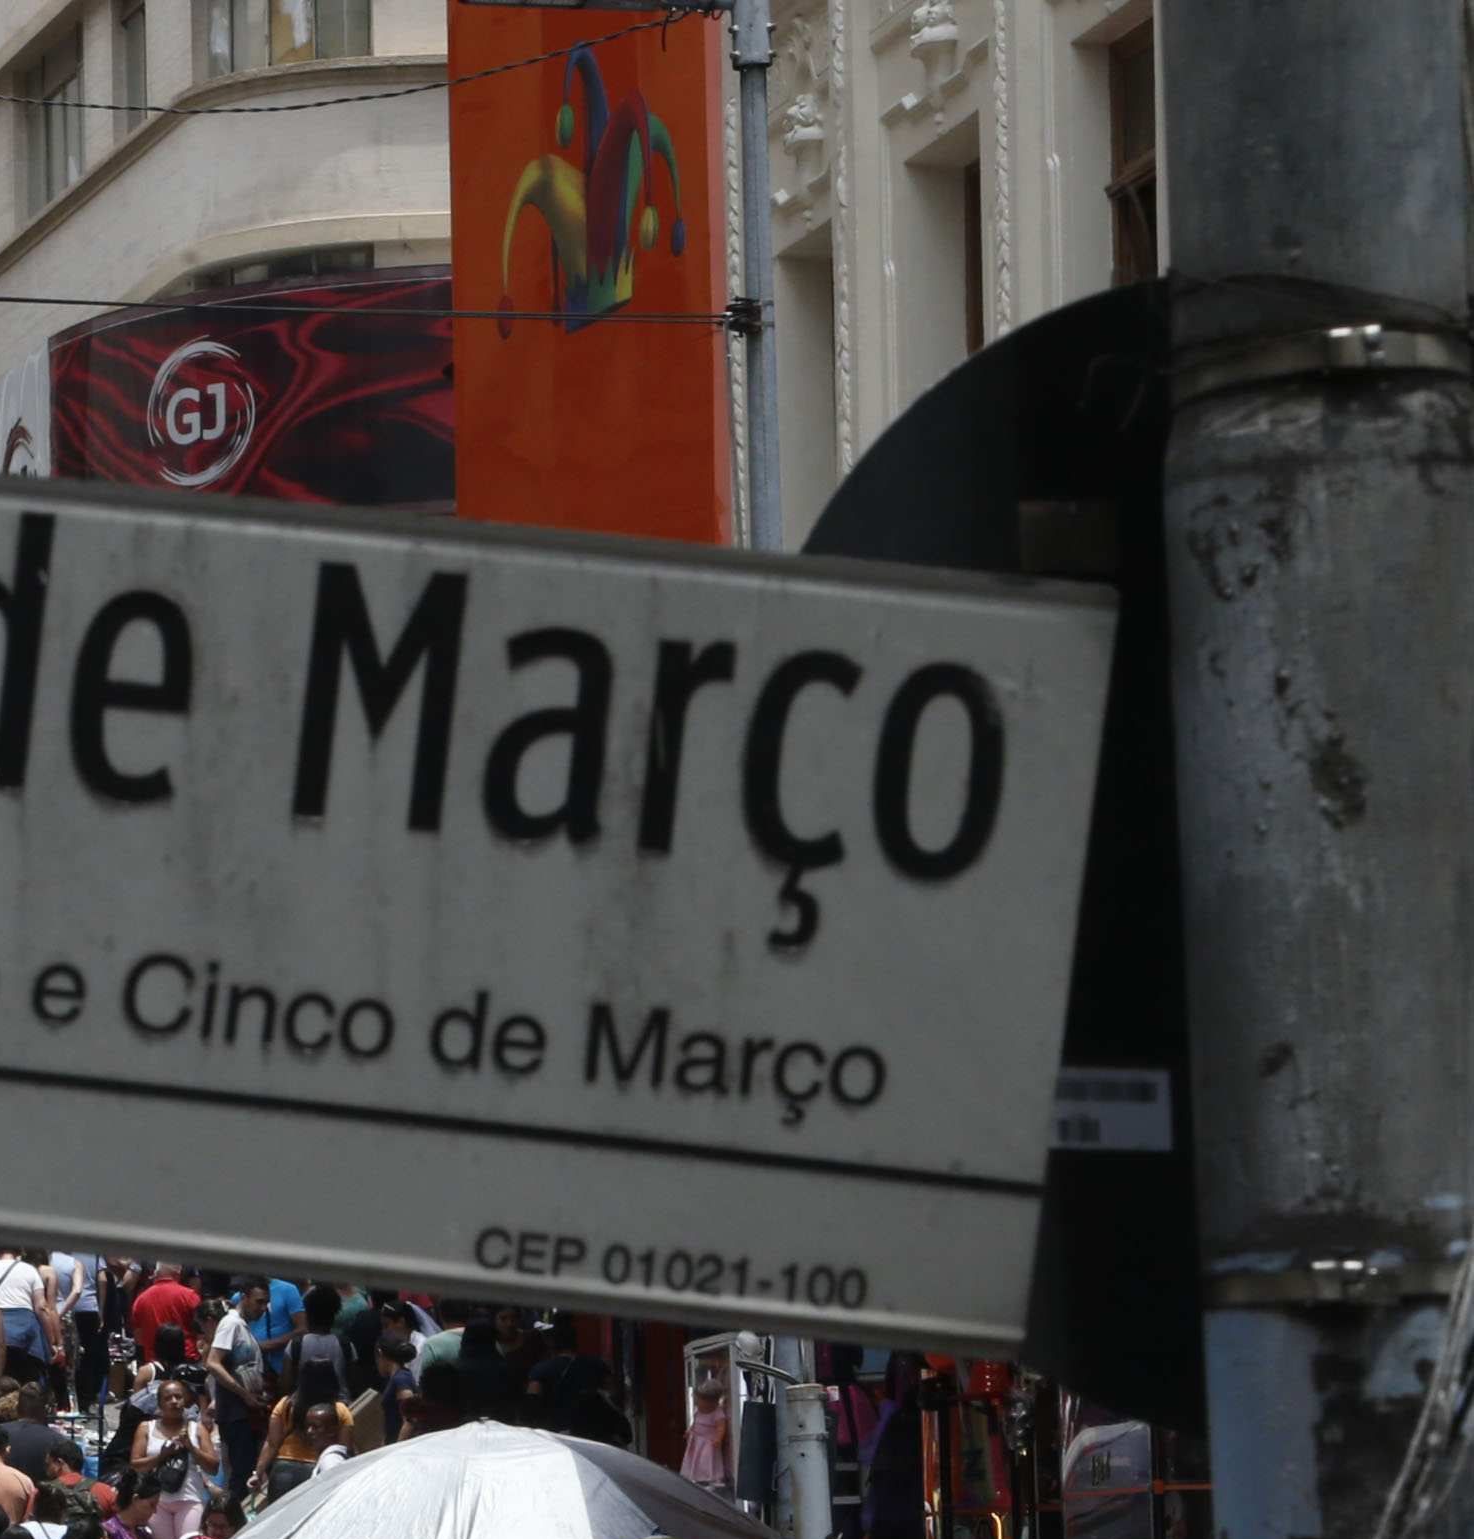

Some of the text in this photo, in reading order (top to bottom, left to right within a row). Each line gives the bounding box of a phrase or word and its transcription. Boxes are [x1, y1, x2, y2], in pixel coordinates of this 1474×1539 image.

[165, 383, 229, 444] GJ
[291, 561, 1006, 957] Março
[31, 964, 85, 1023] e
[123, 953, 395, 1060] Cinco
[429, 991, 546, 1075] de
[584, 1005, 886, 1123] Março
[474, 1227, 868, 1309] CEP 01021-100
